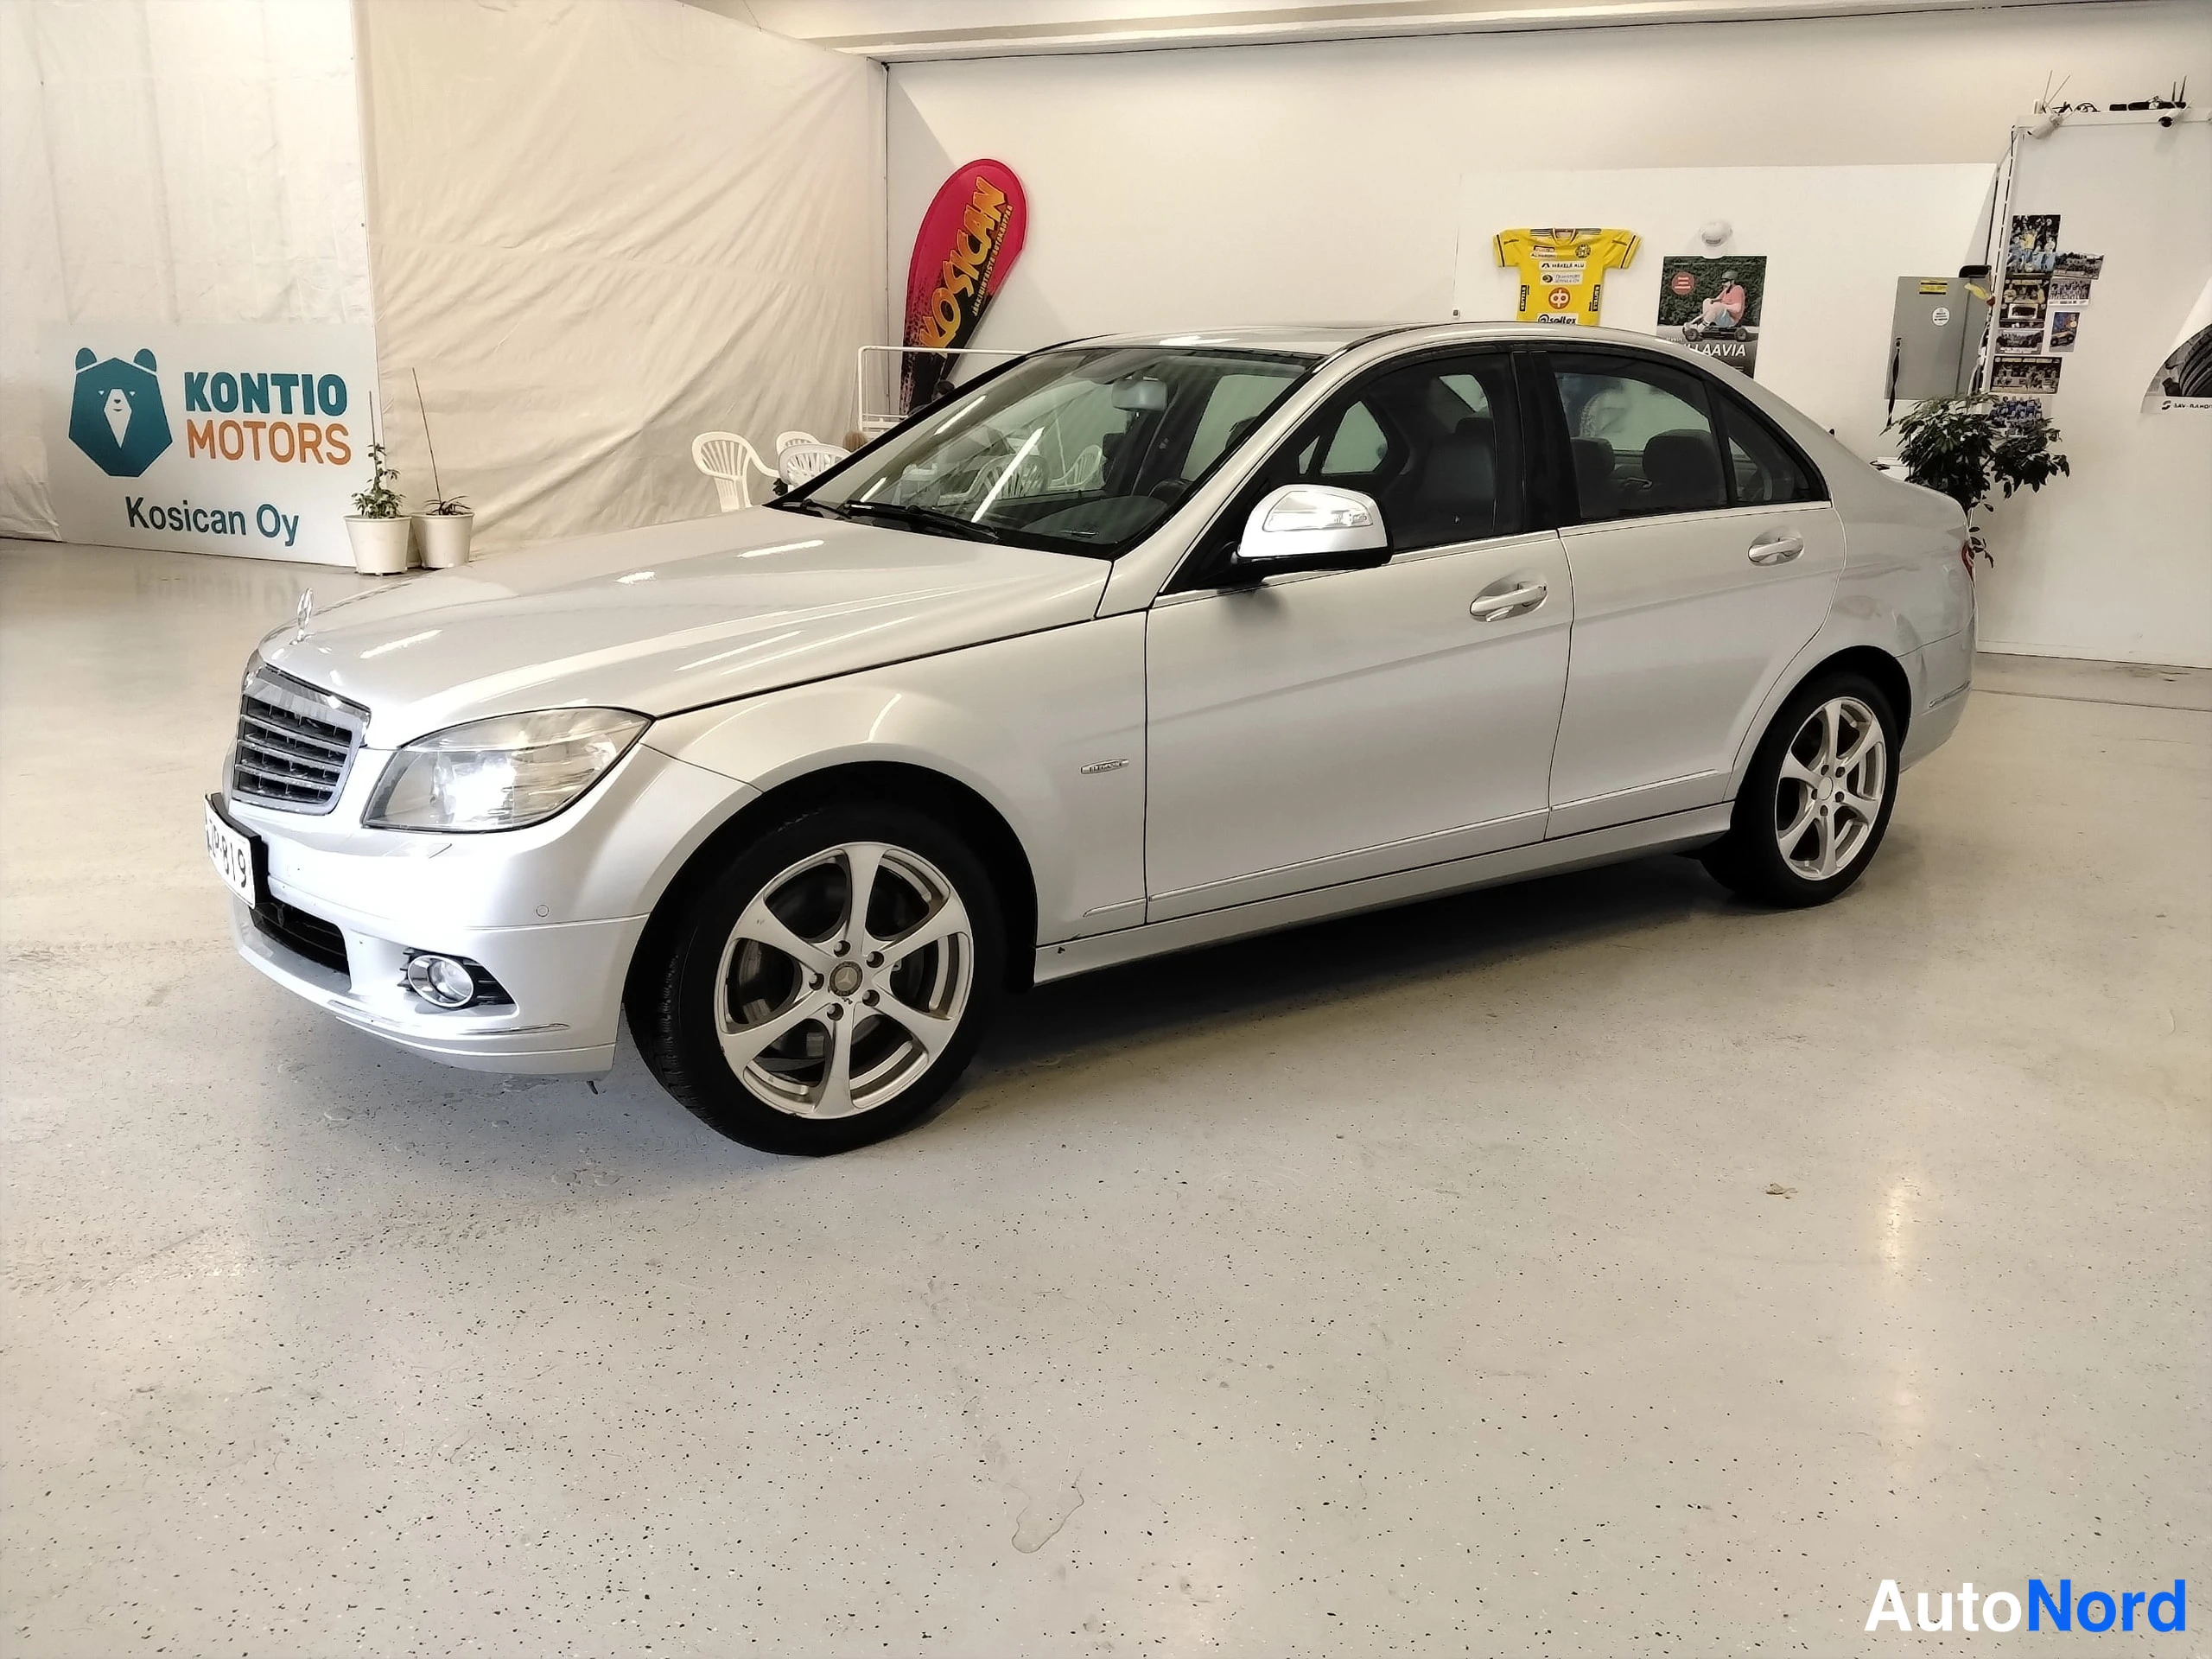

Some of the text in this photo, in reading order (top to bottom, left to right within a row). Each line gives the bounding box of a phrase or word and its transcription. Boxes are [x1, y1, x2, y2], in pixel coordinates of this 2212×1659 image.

[920, 175, 1006, 359] KOSICAN
[184, 372, 347, 416] KONTIO
[186, 418, 352, 466] MOTORS
[124, 495, 300, 547] Kosican Oy
